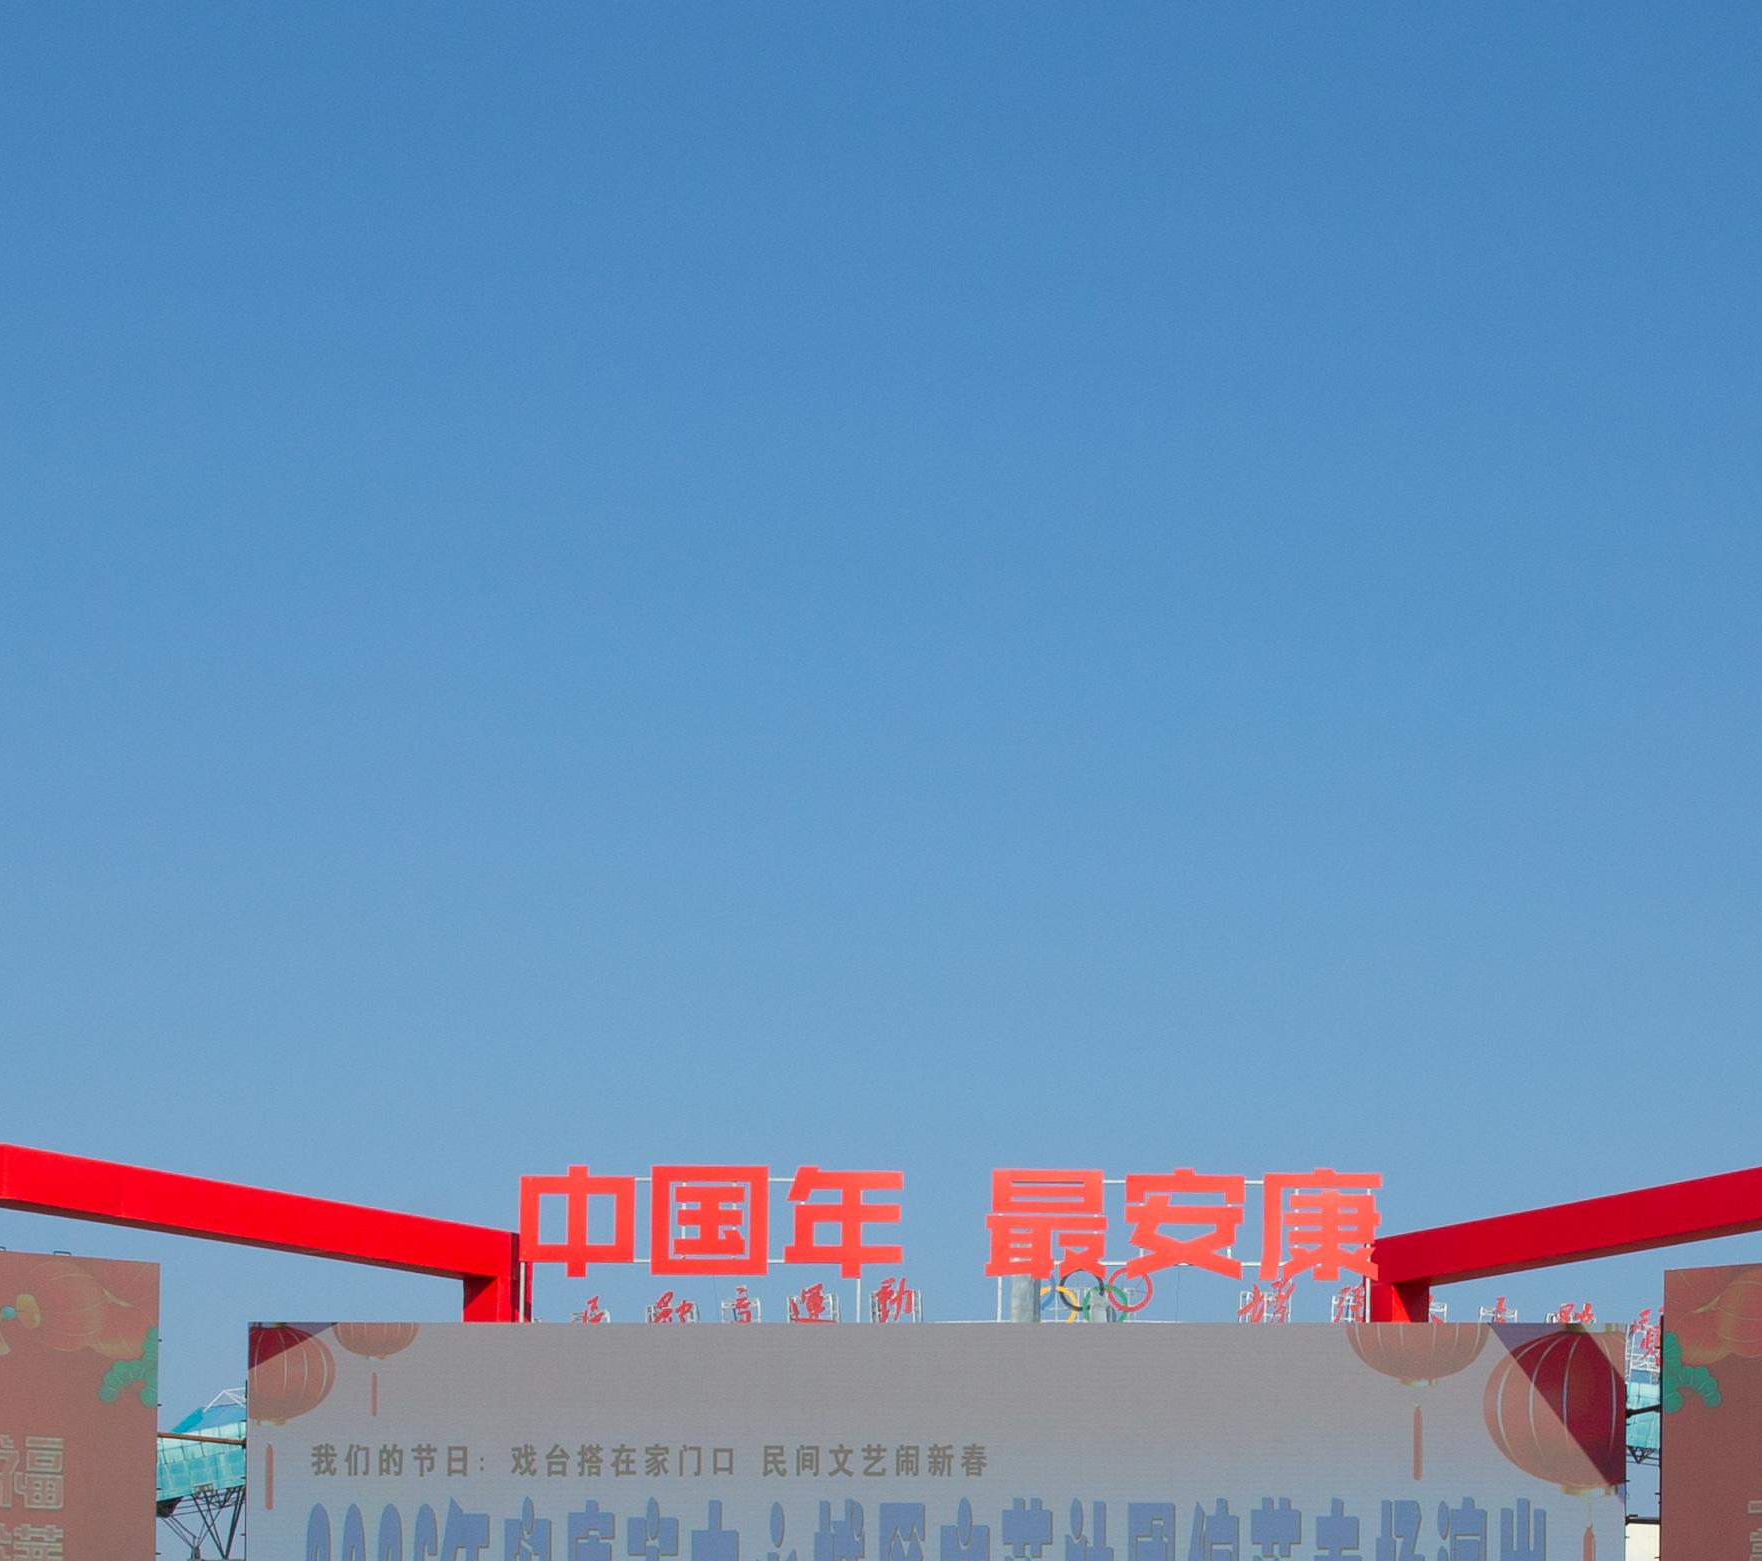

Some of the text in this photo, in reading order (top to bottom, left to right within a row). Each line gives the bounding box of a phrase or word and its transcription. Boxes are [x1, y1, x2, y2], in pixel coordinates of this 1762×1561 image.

[519, 1164, 1384, 1282] 中国年 最安康
[762, 1443, 988, 1477] 民间文艺闹新春
